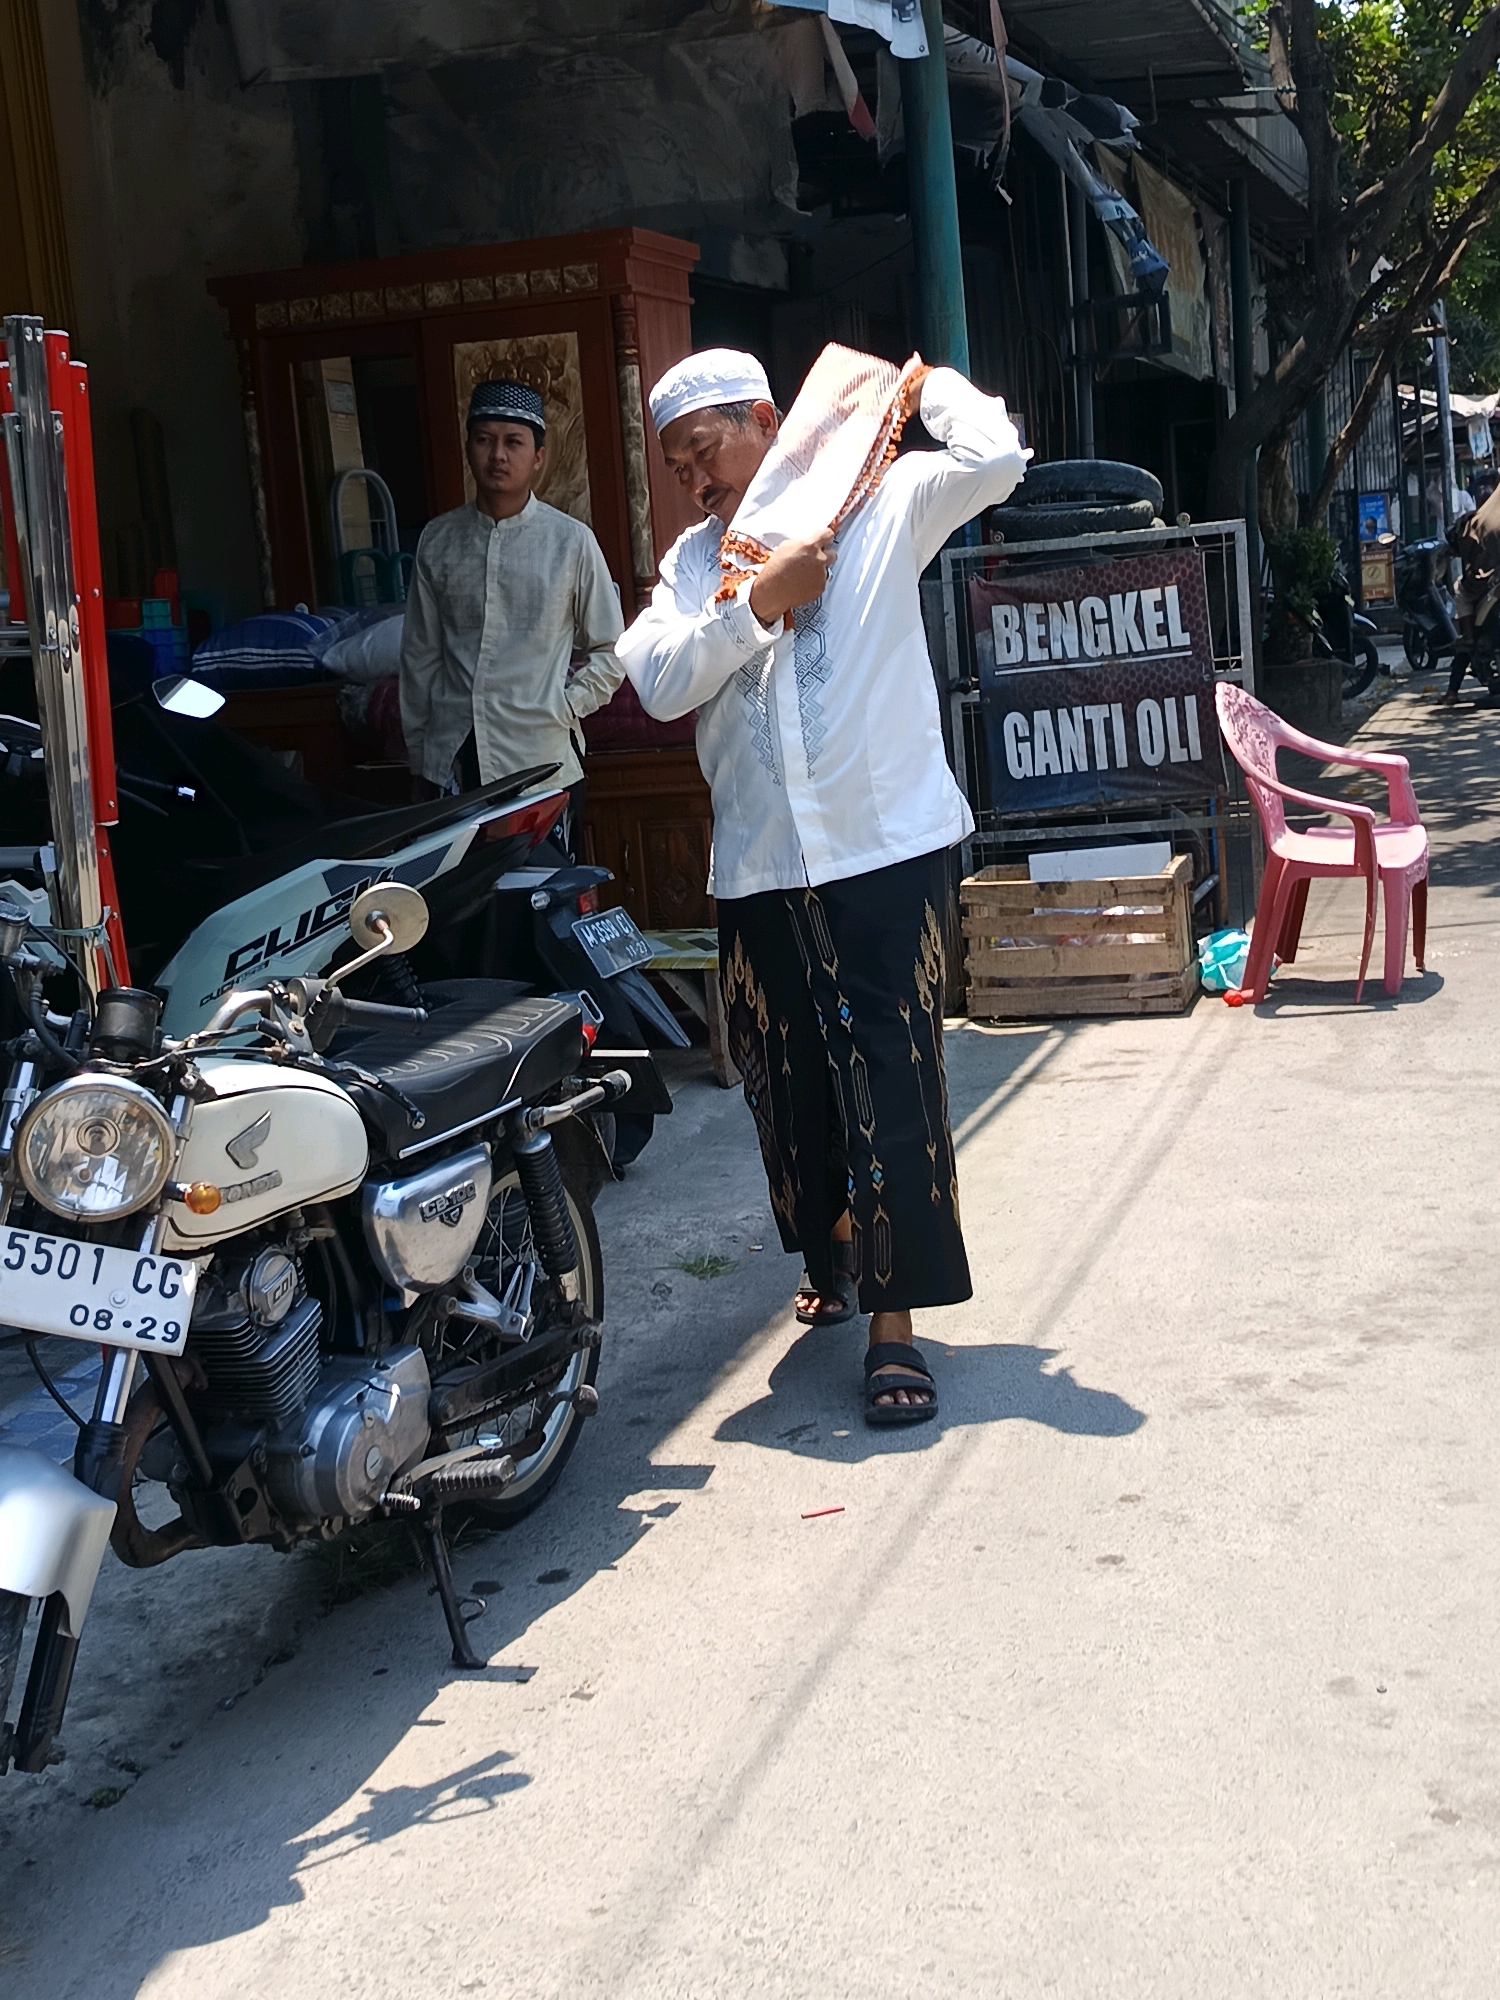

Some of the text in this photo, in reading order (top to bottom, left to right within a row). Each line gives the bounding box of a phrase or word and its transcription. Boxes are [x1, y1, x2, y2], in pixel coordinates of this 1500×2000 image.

[991, 585, 1191, 666] BENGKEL
[1003, 695, 1203, 779] GANTI OLI
[581, 925, 599, 947] M
[4, 1231, 182, 1299] 5501 CG
[272, 1271, 293, 1305] CDI
